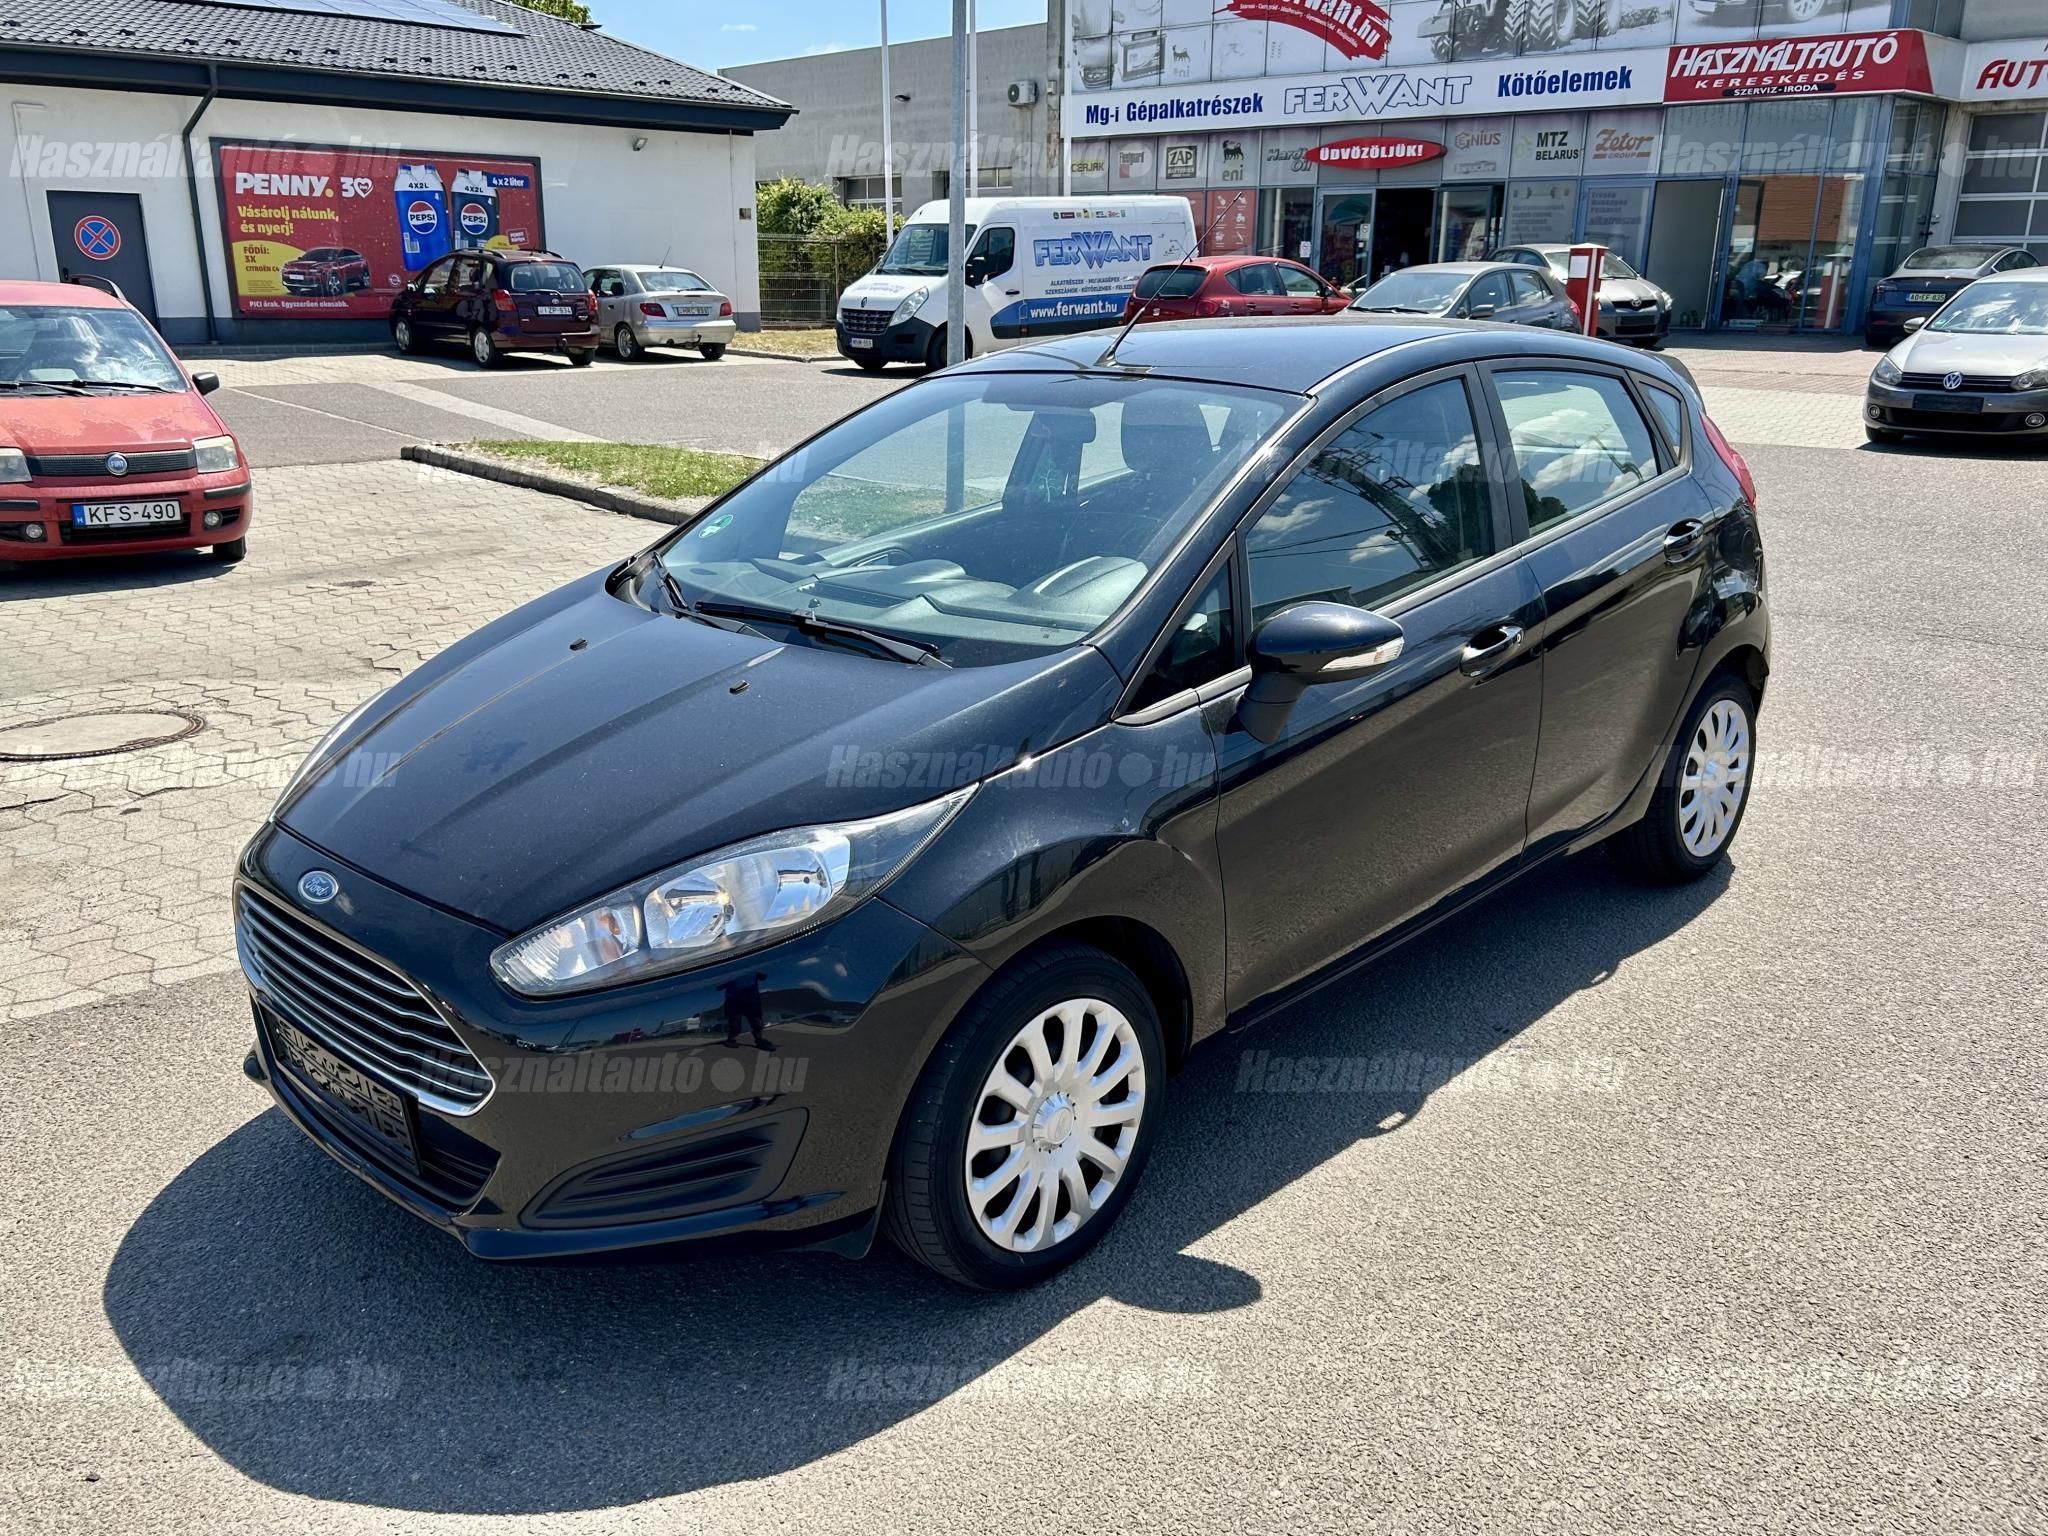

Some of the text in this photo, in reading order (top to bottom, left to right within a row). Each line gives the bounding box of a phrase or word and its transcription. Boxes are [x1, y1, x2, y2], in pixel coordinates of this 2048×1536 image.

[1670, 32, 1899, 78] HASZNÁLTAUTÓ
[1976, 44, 2048, 90] AUT
[1497, 65, 1633, 98] Kötőelemek
[1695, 68, 1866, 89] KERESKEDÉS
[1734, 83, 1819, 96] SZERVIZ-IRODA
[1086, 92, 1264, 126] Mg-i Gépalkatrészek
[1536, 130, 1569, 148] MTZ
[1595, 128, 1655, 152] Zetor
[1169, 150, 1193, 165] ZAP
[1319, 144, 1423, 161] ÜDVÖZÖLJÜK!
[1535, 148, 1579, 161] BELARUS
[1222, 164, 1244, 182] eni
[237, 204, 340, 222] Vásárolj nálunk,
[409, 213, 435, 222] PEPSI
[462, 214, 486, 224] PEPSI
[240, 220, 294, 236] és nyerj!
[244, 255, 256, 263] 3X
[1030, 300, 1118, 318] www.ferwant.hu
[88, 503, 176, 523] KFS-490
[304, 875, 330, 898] Ford
